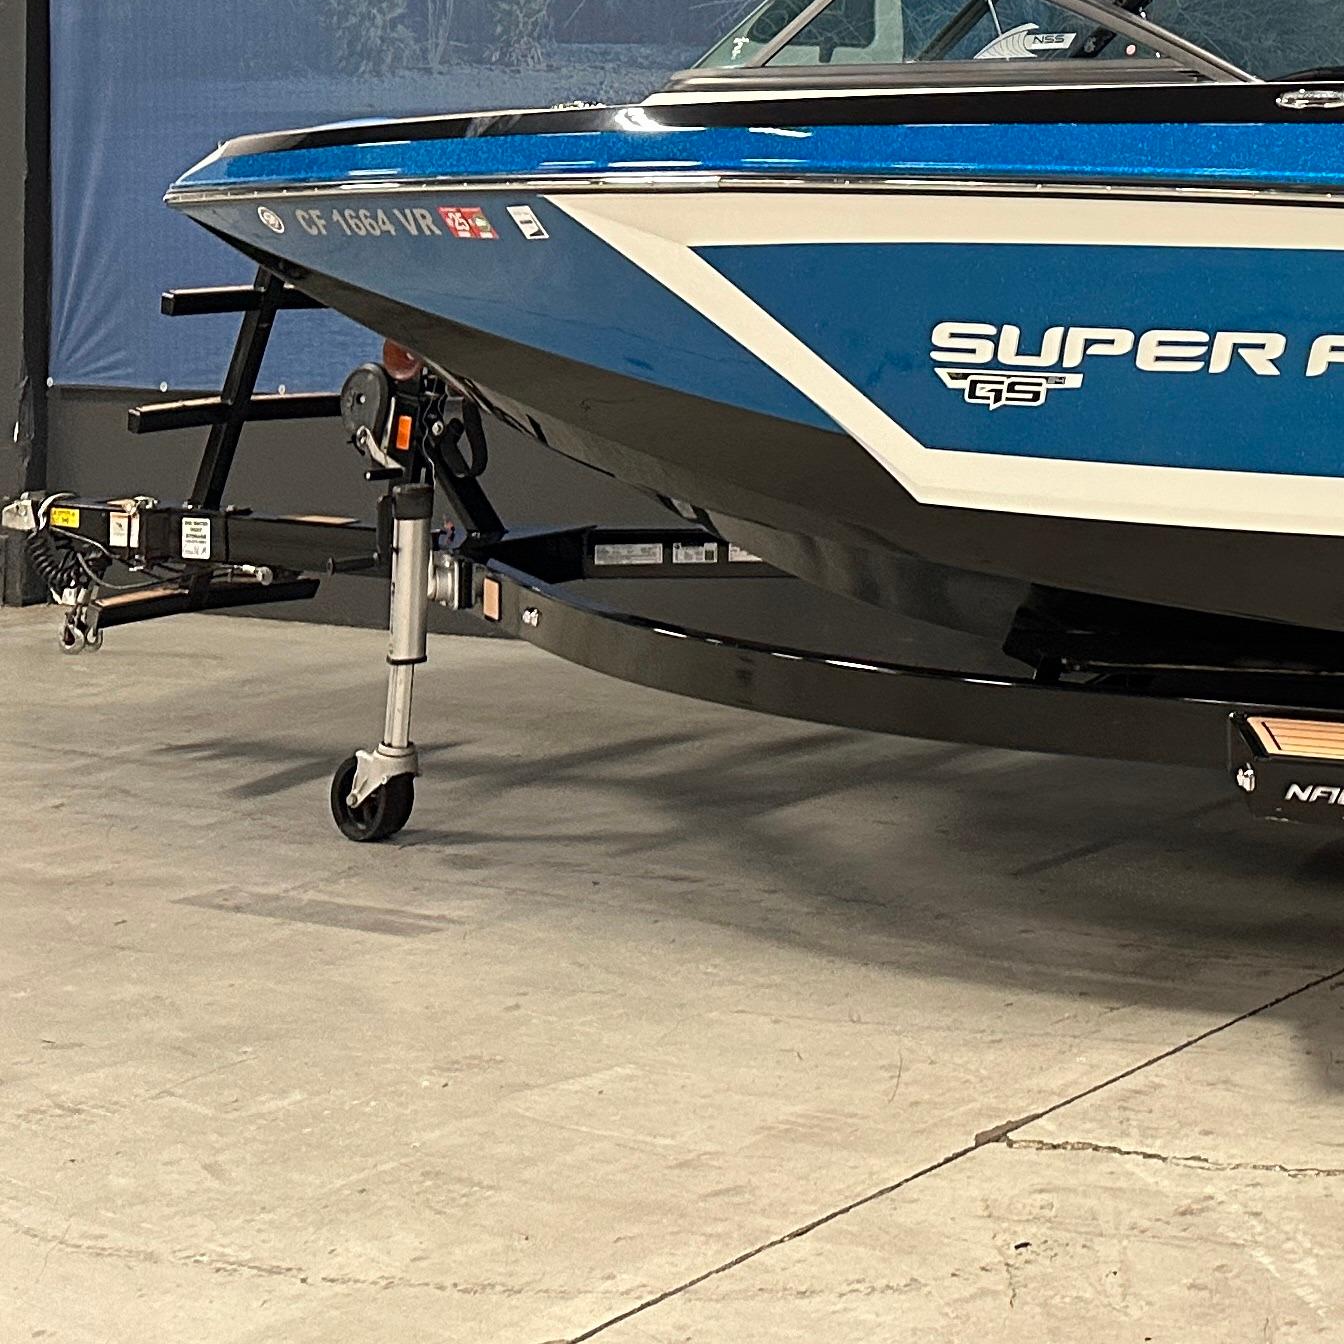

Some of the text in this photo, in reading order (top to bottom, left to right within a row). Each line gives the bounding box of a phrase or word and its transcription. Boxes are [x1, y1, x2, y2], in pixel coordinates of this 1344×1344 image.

[1031, 34, 1065, 45] NSS
[295, 207, 328, 236] CF
[332, 208, 396, 236] 1664
[393, 208, 442, 236] VR
[929, 321, 1287, 378] SUPER
[967, 379, 1043, 405] GS
